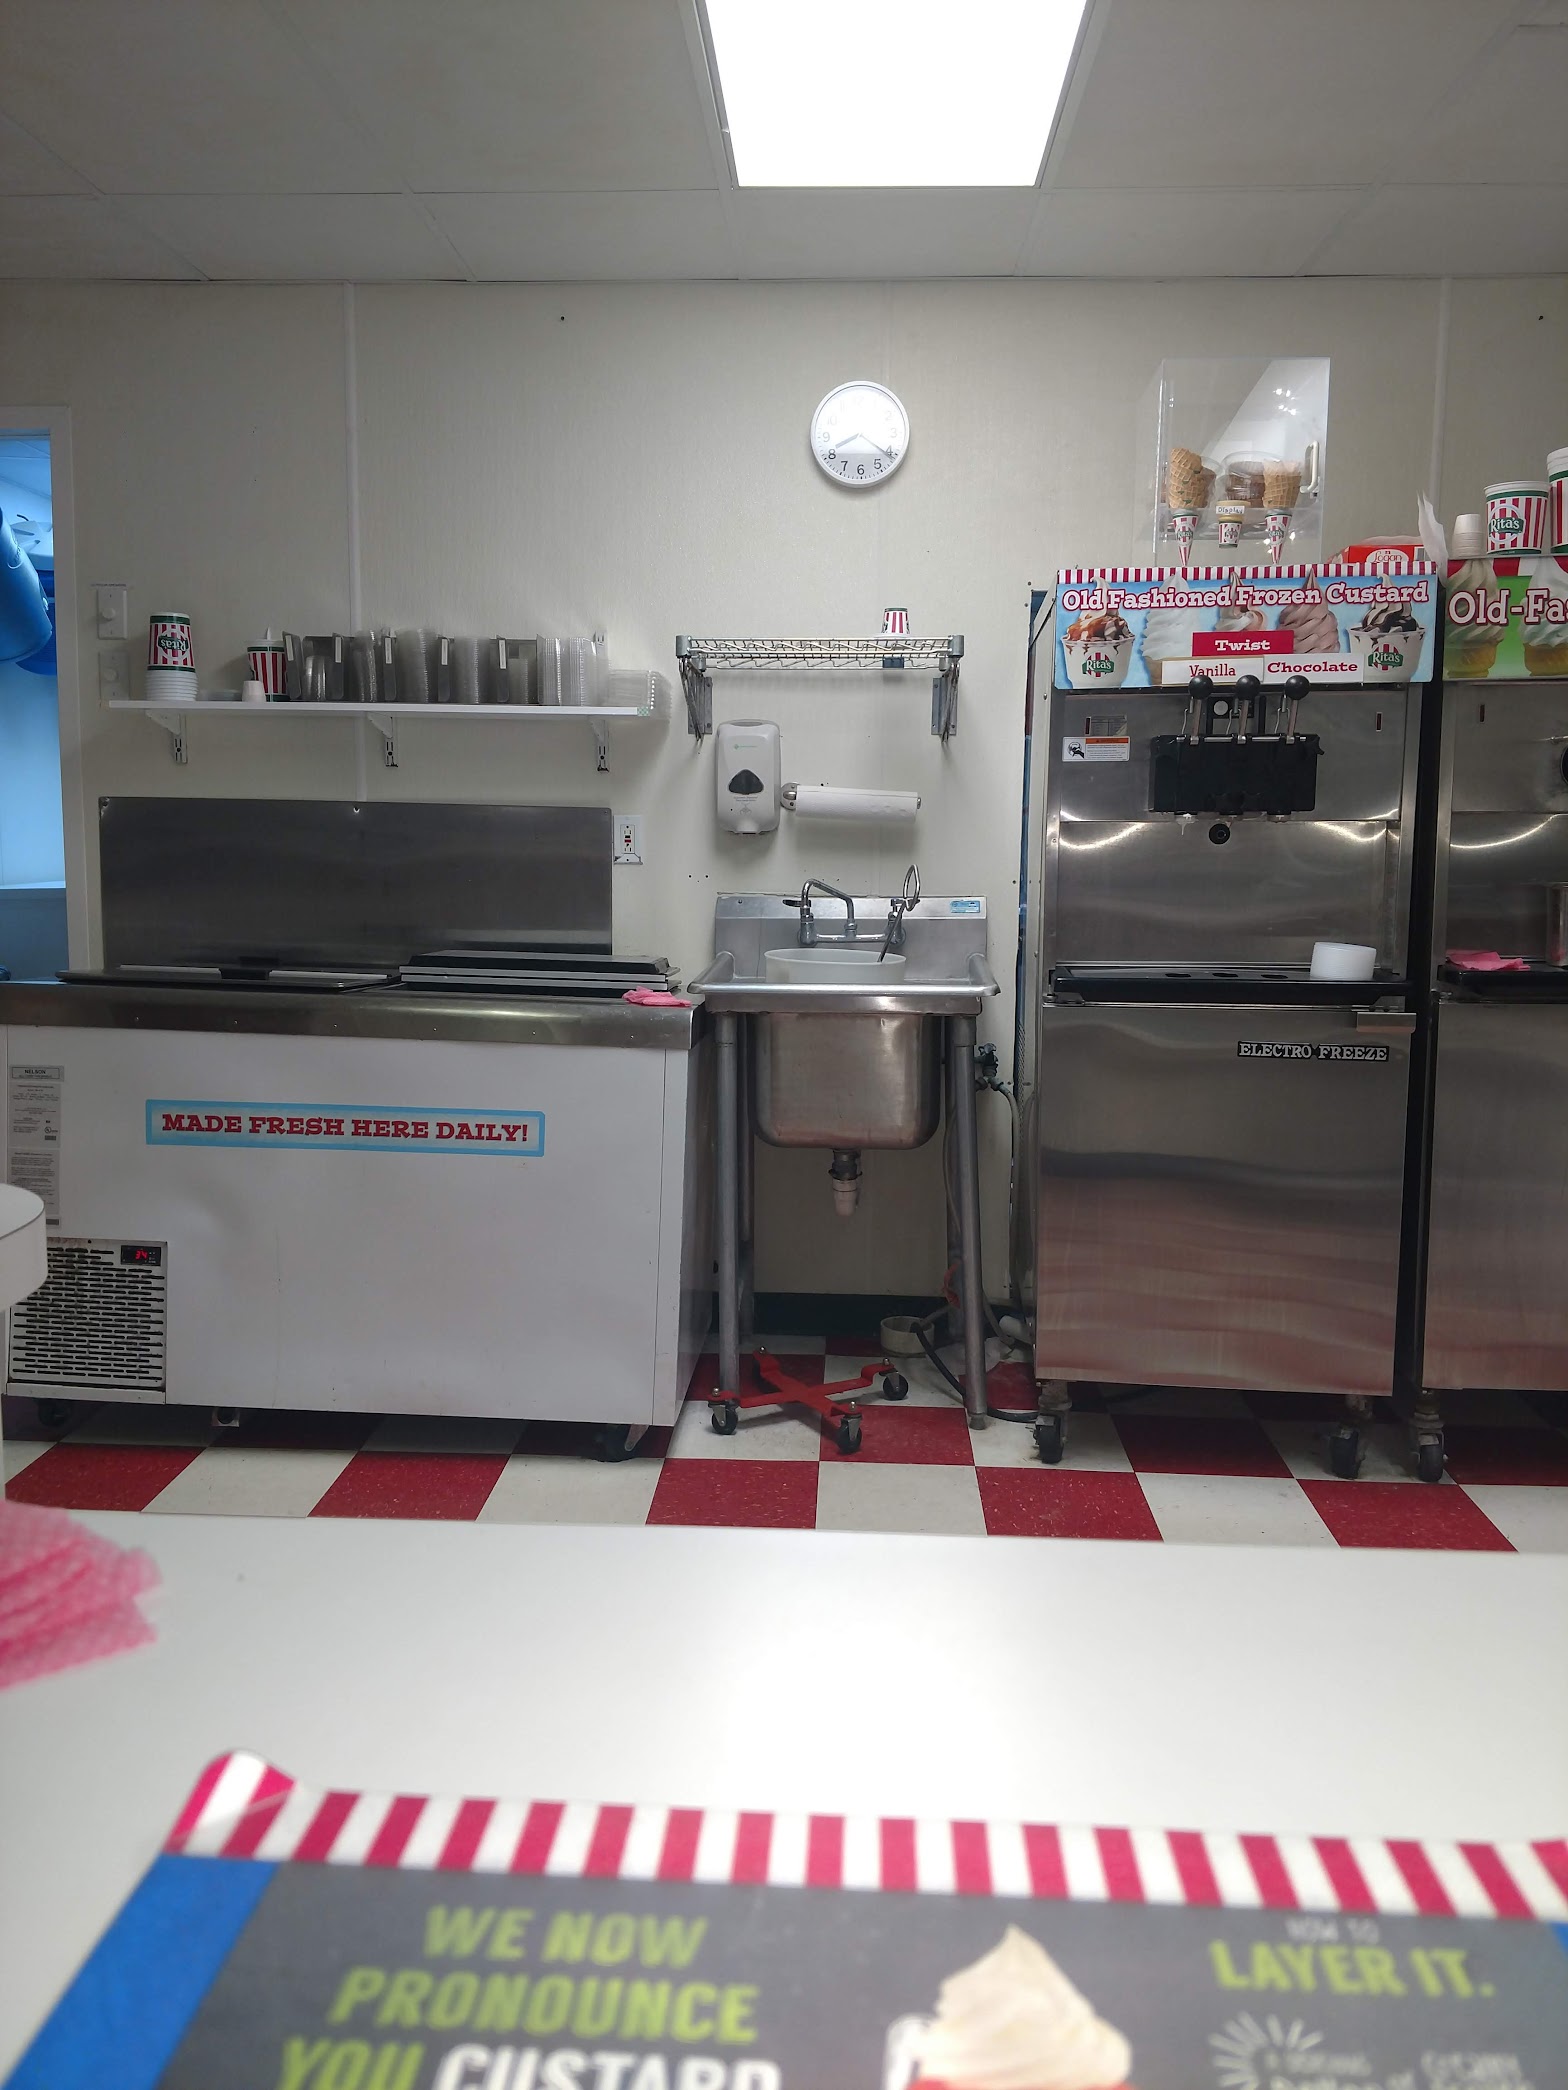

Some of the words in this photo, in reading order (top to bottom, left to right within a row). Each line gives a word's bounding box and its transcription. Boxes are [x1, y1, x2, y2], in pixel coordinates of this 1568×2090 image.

[822, 431, 831, 443] 9
[890, 427, 898, 438] 3
[828, 448, 837, 460] 8
[840, 460, 849, 472] 7
[856, 464, 865, 476] 6
[873, 458, 882, 470] 5
[1490, 517, 1520, 532] Rita's
[1062, 588, 1104, 611] Old
[1107, 585, 1232, 610] Fashioned
[1235, 585, 1321, 606] Frozen
[1326, 580, 1429, 604] Custard
[160, 640, 187, 652] Rita's
[1215, 640, 1271, 651] Twist
[1373, 651, 1401, 663] Rita's
[1086, 659, 1112, 671] Rita's
[1189, 664, 1236, 677] Vanilla
[1267, 662, 1358, 673] Chocolate
[1239, 1043, 1312, 1058] ELECTRO
[1318, 1045, 1387, 1061] FREEZE
[162, 1113, 242, 1134] MADE
[249, 1116, 345, 1137] FRESH
[351, 1118, 429, 1139] HERE
[436, 1122, 529, 1142] DAILY!
[424, 1904, 534, 1961] WE
[542, 1911, 707, 1969] NOW
[1209, 1939, 1407, 1996] LAYER
[1409, 1946, 1497, 1997] IT.
[327, 1966, 760, 2044] PRONOUNCE
[277, 2036, 425, 2090] YOU
[432, 2042, 783, 2090] CUSTARD
